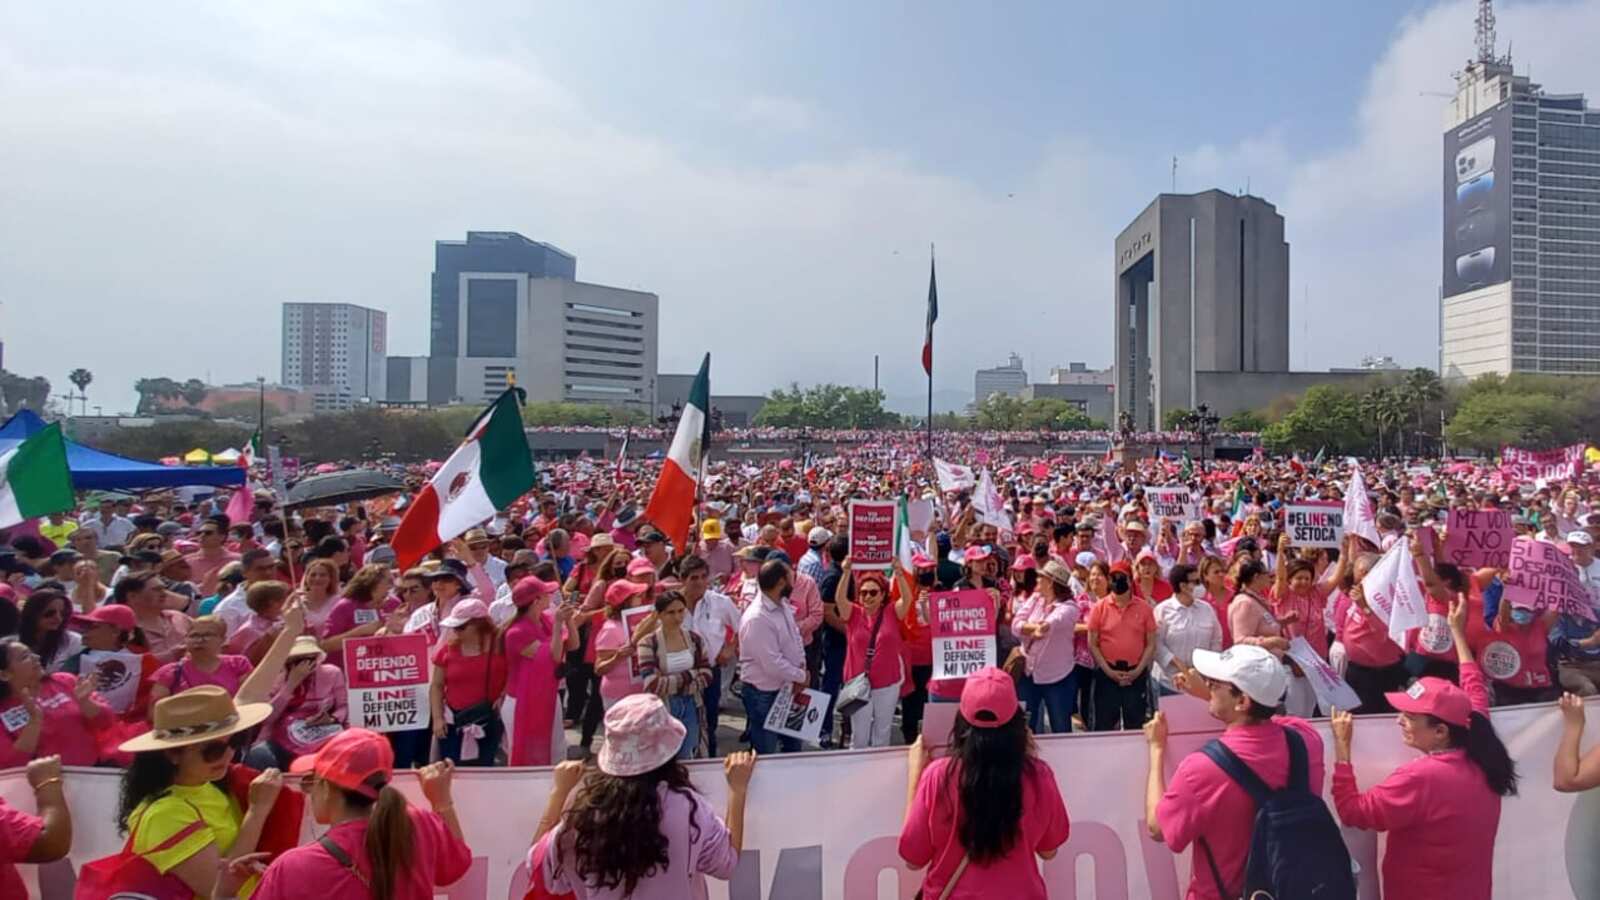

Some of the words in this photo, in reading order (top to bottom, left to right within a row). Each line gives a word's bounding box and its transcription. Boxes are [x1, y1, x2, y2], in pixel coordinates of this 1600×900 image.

[1288, 512, 1343, 527] #ELINENO
[1455, 511, 1478, 529] MI
[1294, 527, 1337, 541] SETOCA
[1464, 531, 1502, 549] NO
[1512, 539, 1533, 557] SI
[1451, 551, 1472, 568] SE
[953, 618, 989, 632] INE
[943, 640, 953, 651] EL
[956, 639, 986, 650] INE
[356, 654, 417, 671] DEFIENDO
[943, 650, 986, 662] DEFIENDE
[373, 665, 420, 683] INE
[943, 662, 958, 676] MI
[363, 691, 375, 702] EL
[378, 688, 416, 701] INE
[363, 700, 417, 714] DEFIENDE
[364, 714, 382, 729] MI
[386, 710, 418, 726] VOZ
